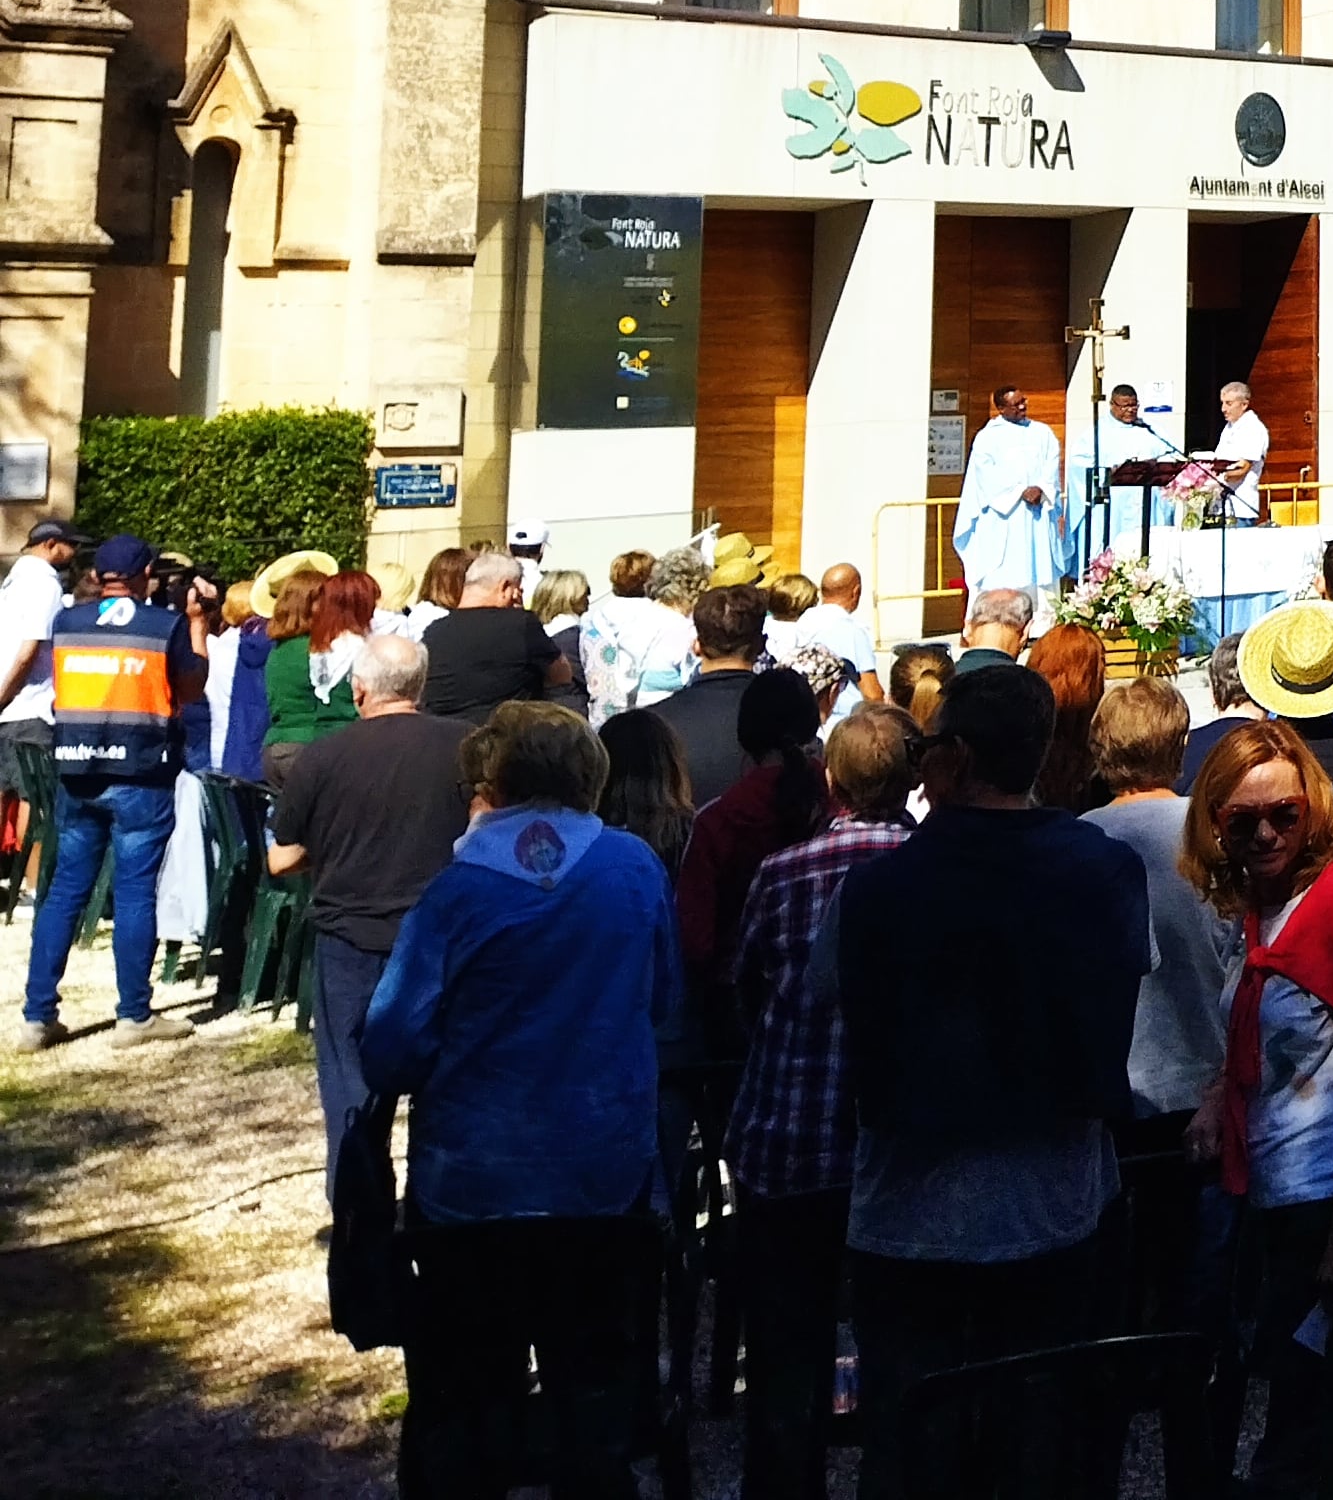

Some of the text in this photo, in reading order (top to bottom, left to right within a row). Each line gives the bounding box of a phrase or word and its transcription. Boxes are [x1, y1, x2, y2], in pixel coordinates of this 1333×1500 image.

[929, 79, 1034, 124] Font Roja
[926, 114, 1075, 170] NATURA
[611, 217, 634, 231] Font
[624, 230, 681, 249] NATURA
[124, 657, 147, 675] TV
